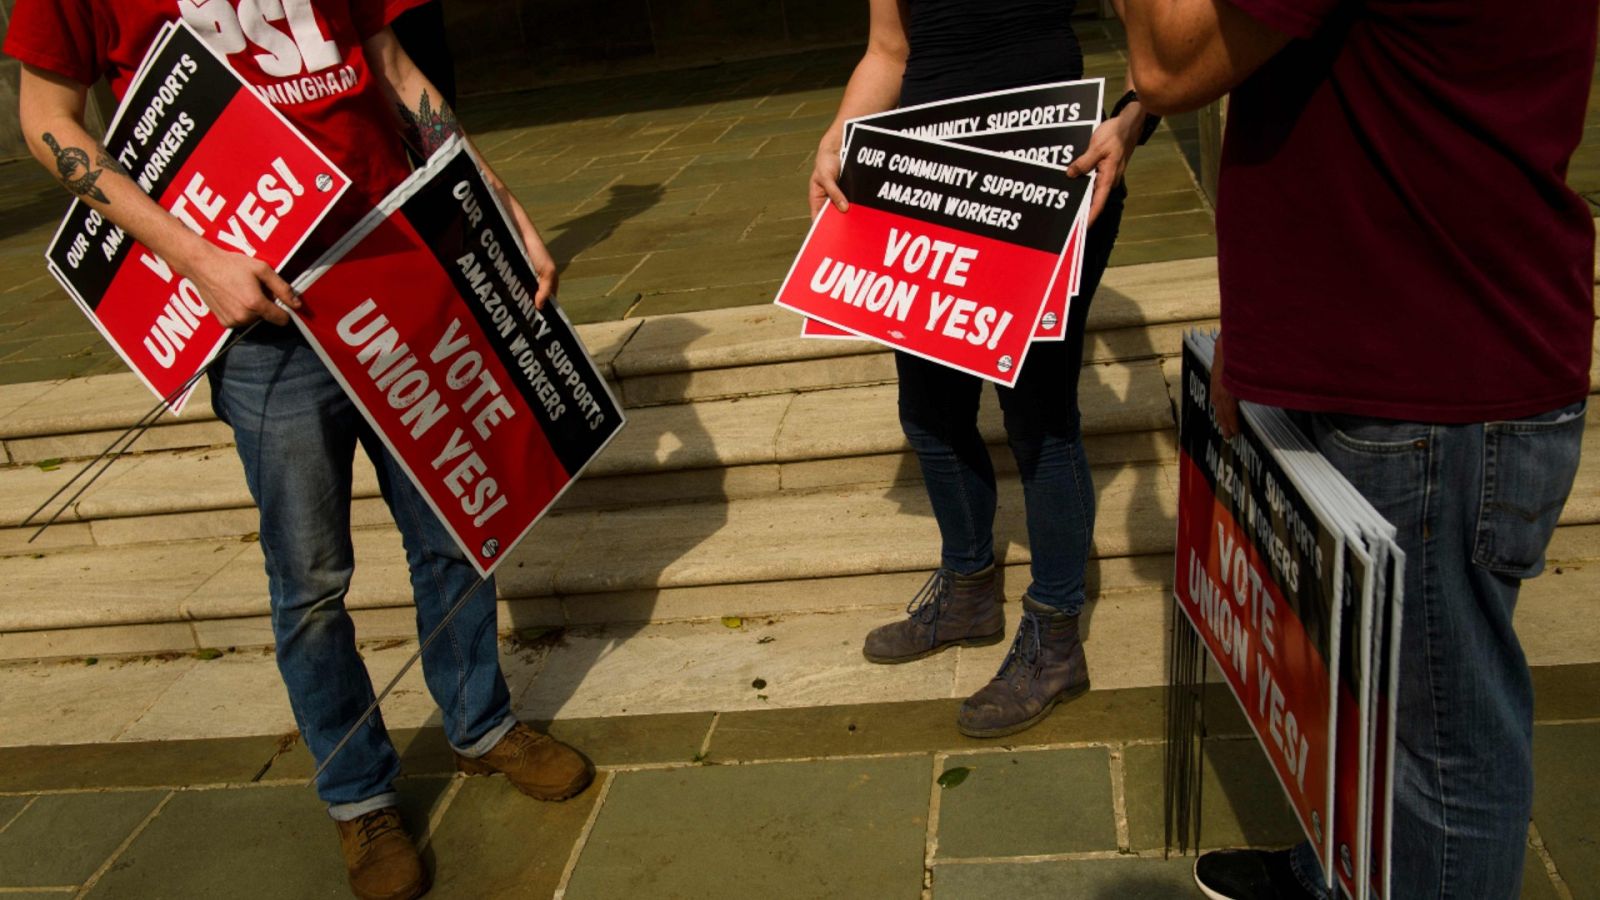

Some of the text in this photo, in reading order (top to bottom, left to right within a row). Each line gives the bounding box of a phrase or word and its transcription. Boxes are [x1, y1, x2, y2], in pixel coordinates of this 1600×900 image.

[256, 65, 358, 104] MINGHAM
[986, 102, 1081, 131] SUPPORTS
[67, 53, 198, 269] OUR SUPPORTS
[102, 224, 126, 262] AMA
[138, 112, 195, 194] WORKERS
[856, 146, 1069, 210] OUR COMMUNITY SUPPORTS
[877, 181, 1022, 231] AMAZON WORKERS
[1000, 144, 1074, 166] PORTS
[140, 172, 227, 284] VTE
[143, 157, 304, 369] UNIO YES!
[883, 228, 979, 287] VOTE
[452, 180, 605, 431] OUR COMMUNITY SUPPORTS
[456, 252, 566, 422] AMAZON WORKERS
[810, 257, 1014, 350] UNION YES!
[336, 298, 509, 527] UNION YES!
[429, 318, 515, 441] VOTE
[1189, 370, 1206, 411] OUR
[1264, 471, 1323, 580] SUPPORTS
[1205, 439, 1299, 593] AMAZON WORKERS
[1218, 522, 1276, 659] VOTE
[1189, 547, 1309, 794] UNION YES!
